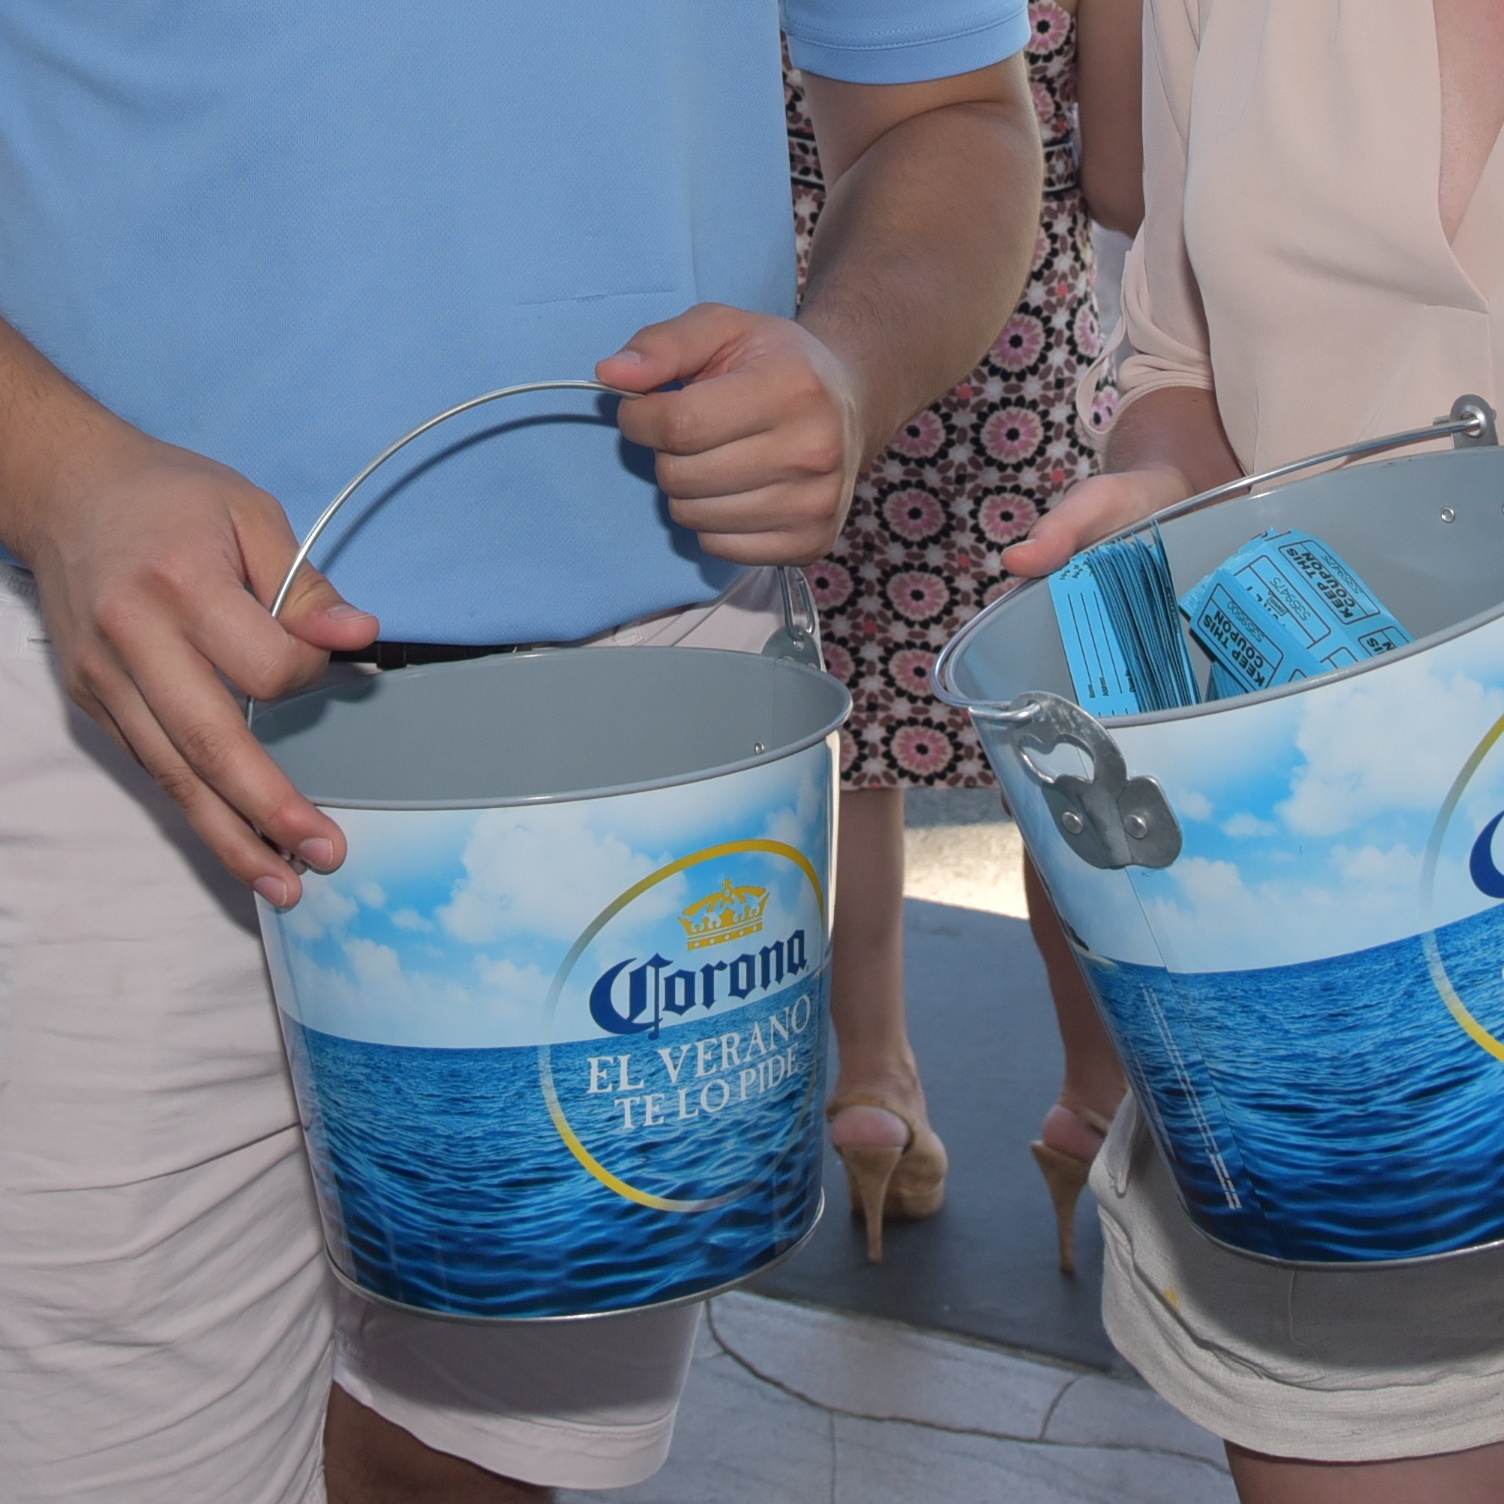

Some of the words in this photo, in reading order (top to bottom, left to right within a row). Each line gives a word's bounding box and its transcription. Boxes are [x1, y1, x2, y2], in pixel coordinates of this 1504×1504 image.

[1286, 547, 1315, 580] THIS
[1301, 552, 1356, 608] COUPON
[1269, 577, 1311, 622] 5359475
[1317, 581, 1354, 619] KEEP
[1203, 614, 1231, 655] THIS
[1213, 610, 1264, 669] COUPON
[1231, 650, 1265, 688] KEEP
[588, 929, 808, 1040] Corona
[586, 1053, 645, 1094] EL
[658, 994, 812, 1085] VERANO
[614, 1093, 666, 1130] TE
[678, 1078, 730, 1121] LO
[739, 1042, 800, 1102] PIDE
